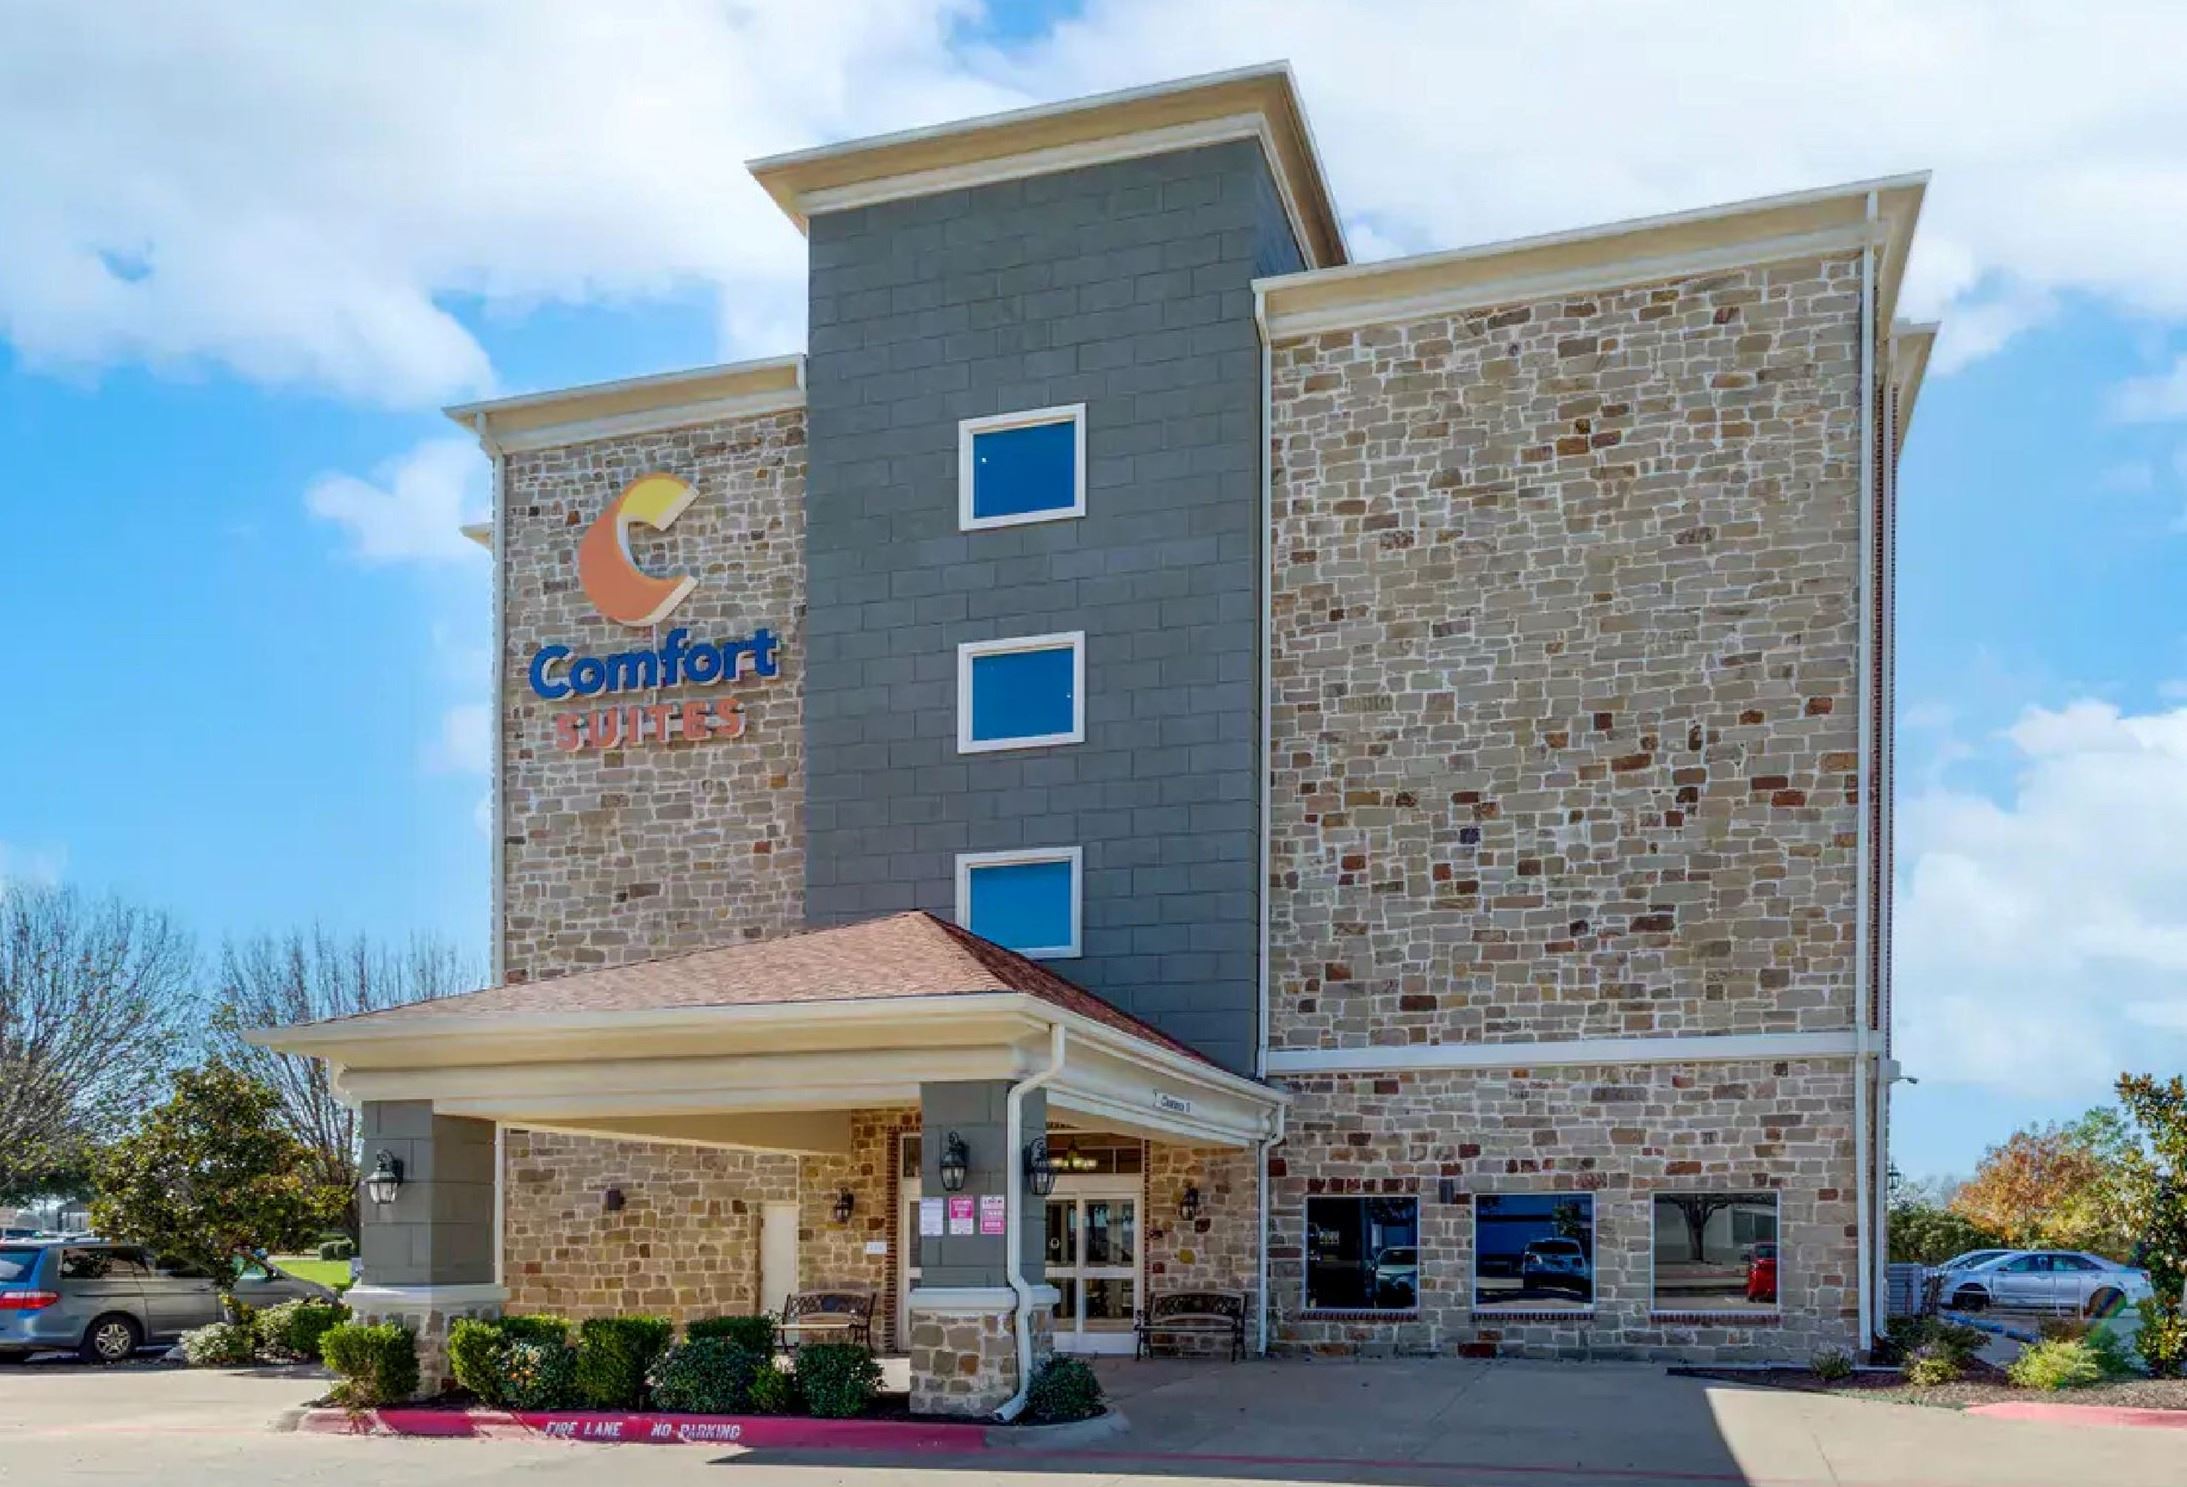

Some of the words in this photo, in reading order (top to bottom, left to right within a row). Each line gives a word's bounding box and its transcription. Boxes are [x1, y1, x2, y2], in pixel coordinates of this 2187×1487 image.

[528, 628, 780, 701] Comfort
[555, 697, 746, 752] SUITES
[545, 1421, 578, 1436] FIRE
[584, 1421, 623, 1436] LANE
[651, 1422, 672, 1437] NO
[679, 1423, 740, 1440] PARKING
